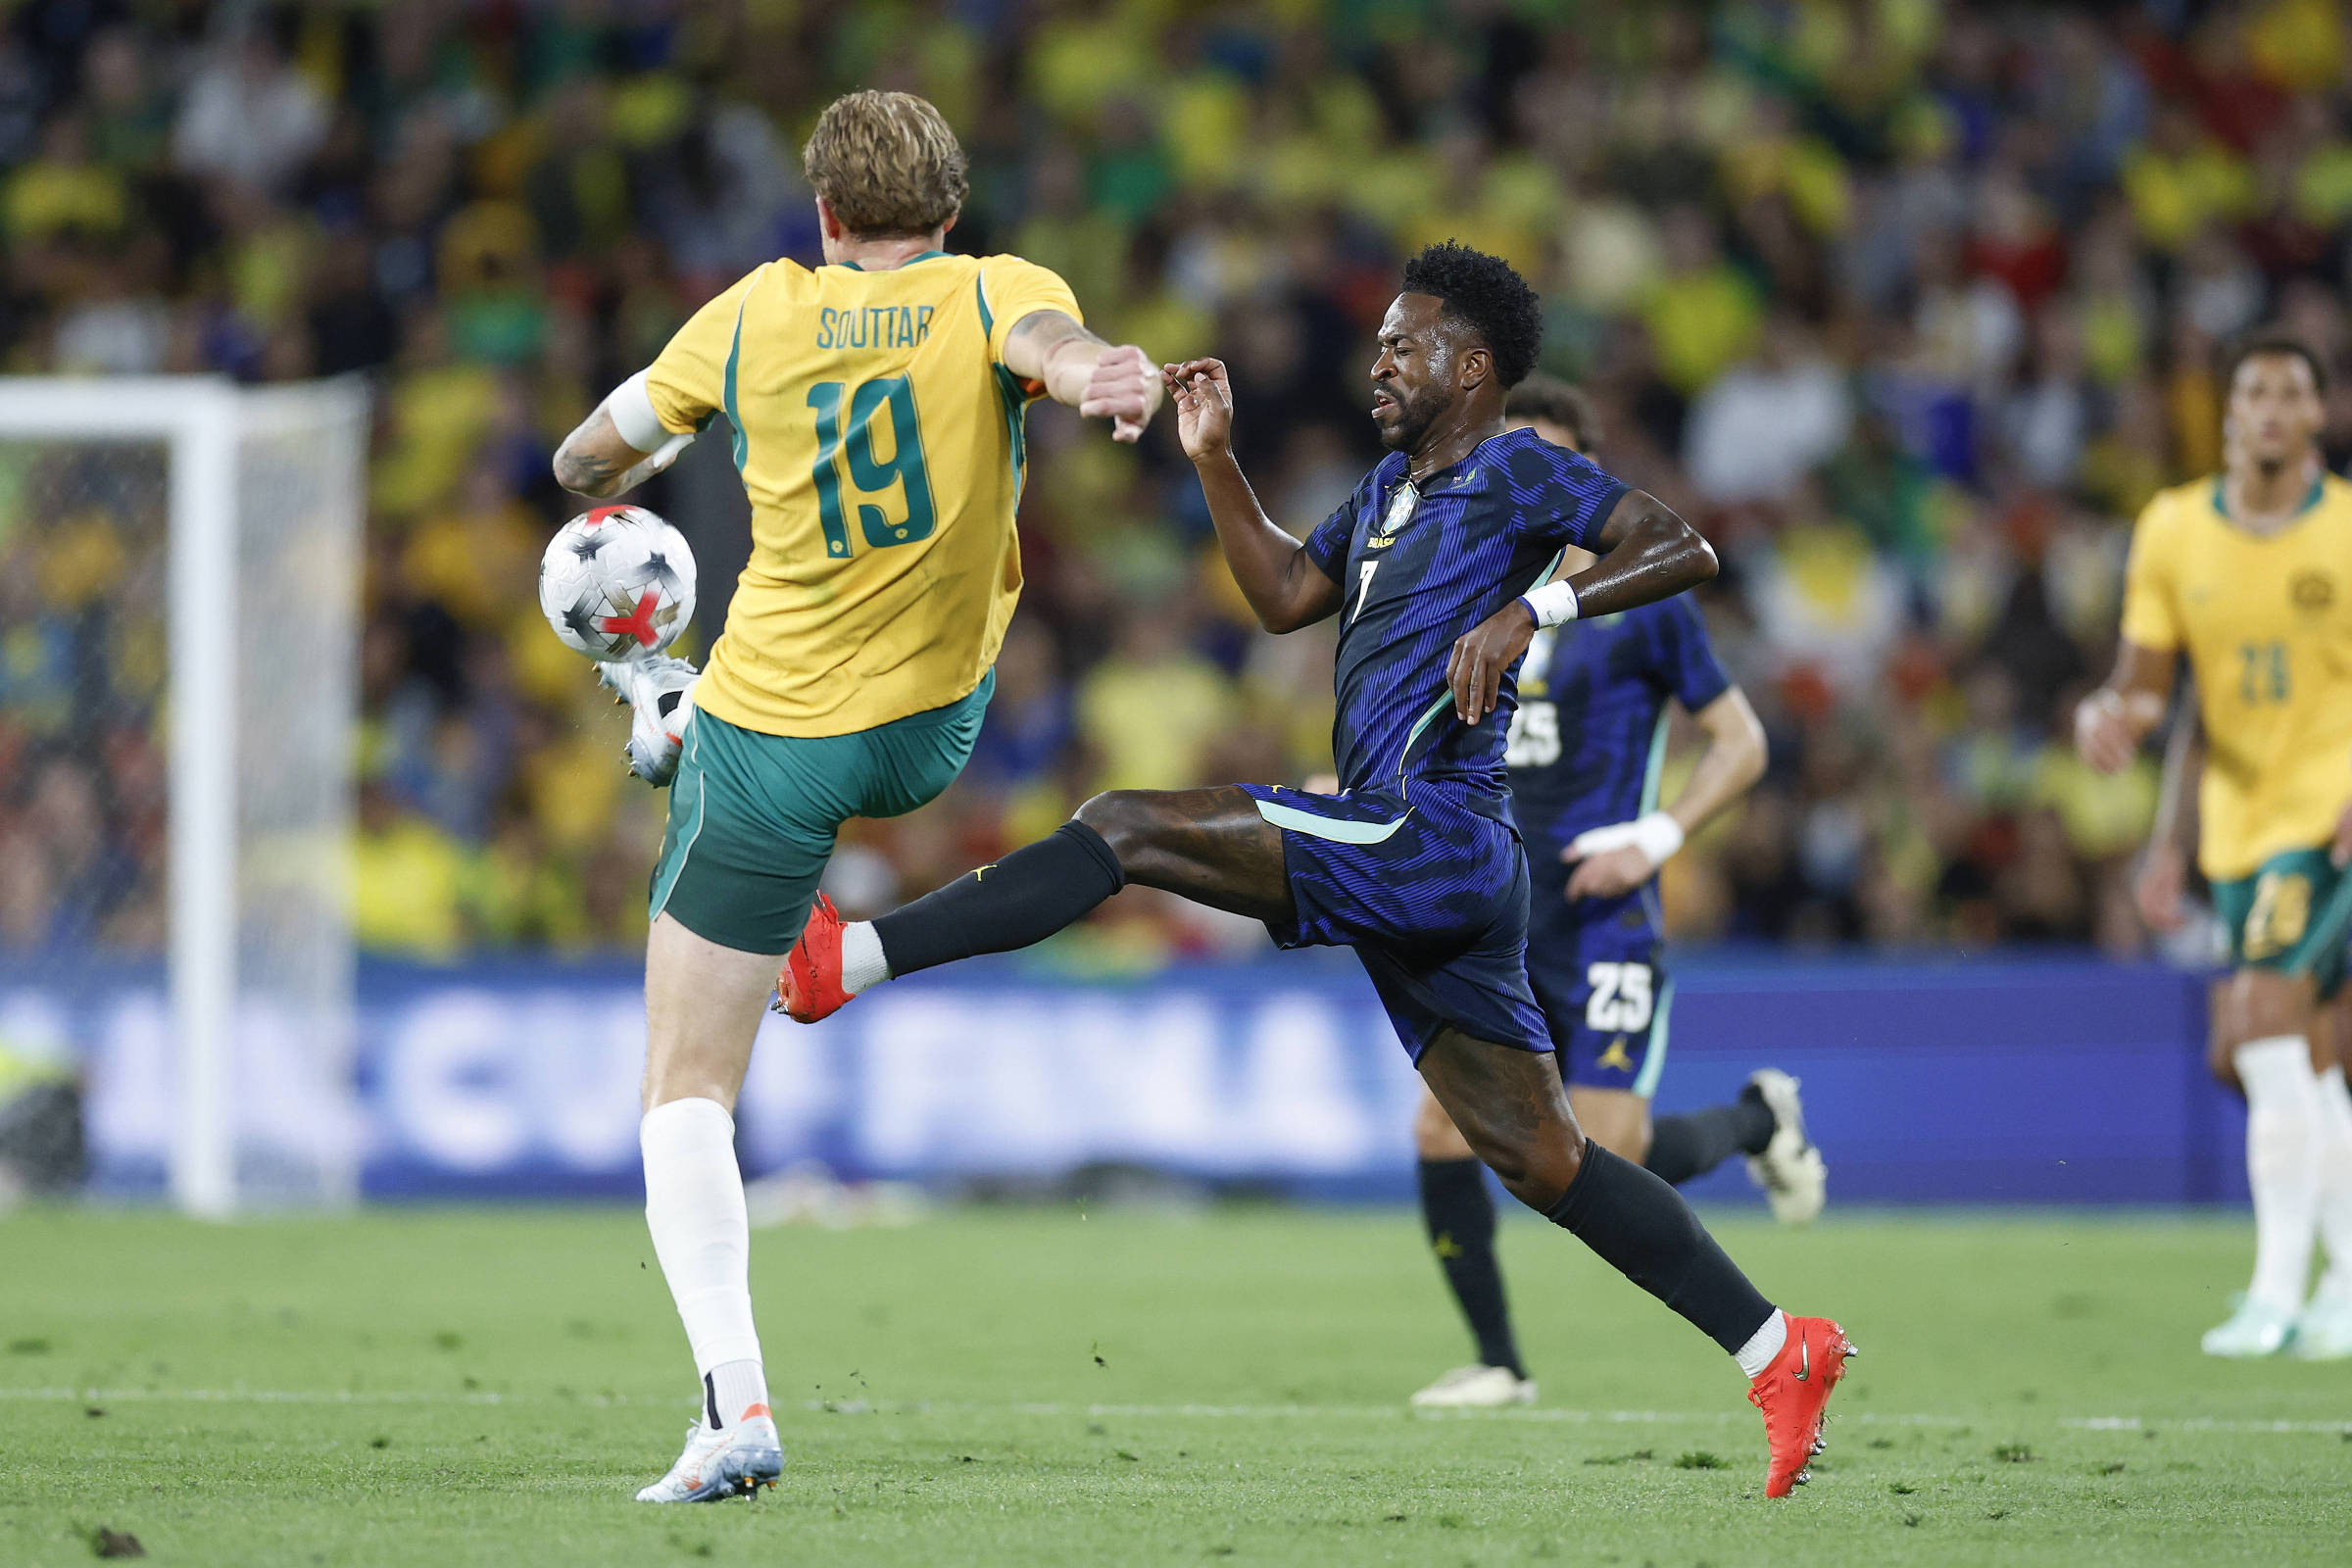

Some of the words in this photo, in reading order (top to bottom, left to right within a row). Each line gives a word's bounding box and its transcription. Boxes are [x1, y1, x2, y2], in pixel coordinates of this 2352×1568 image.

[816, 305, 935, 350] SOUTTAR
[807, 369, 937, 559] 19
[1351, 561, 1380, 624] 7
[1586, 961, 1653, 1033] 25
